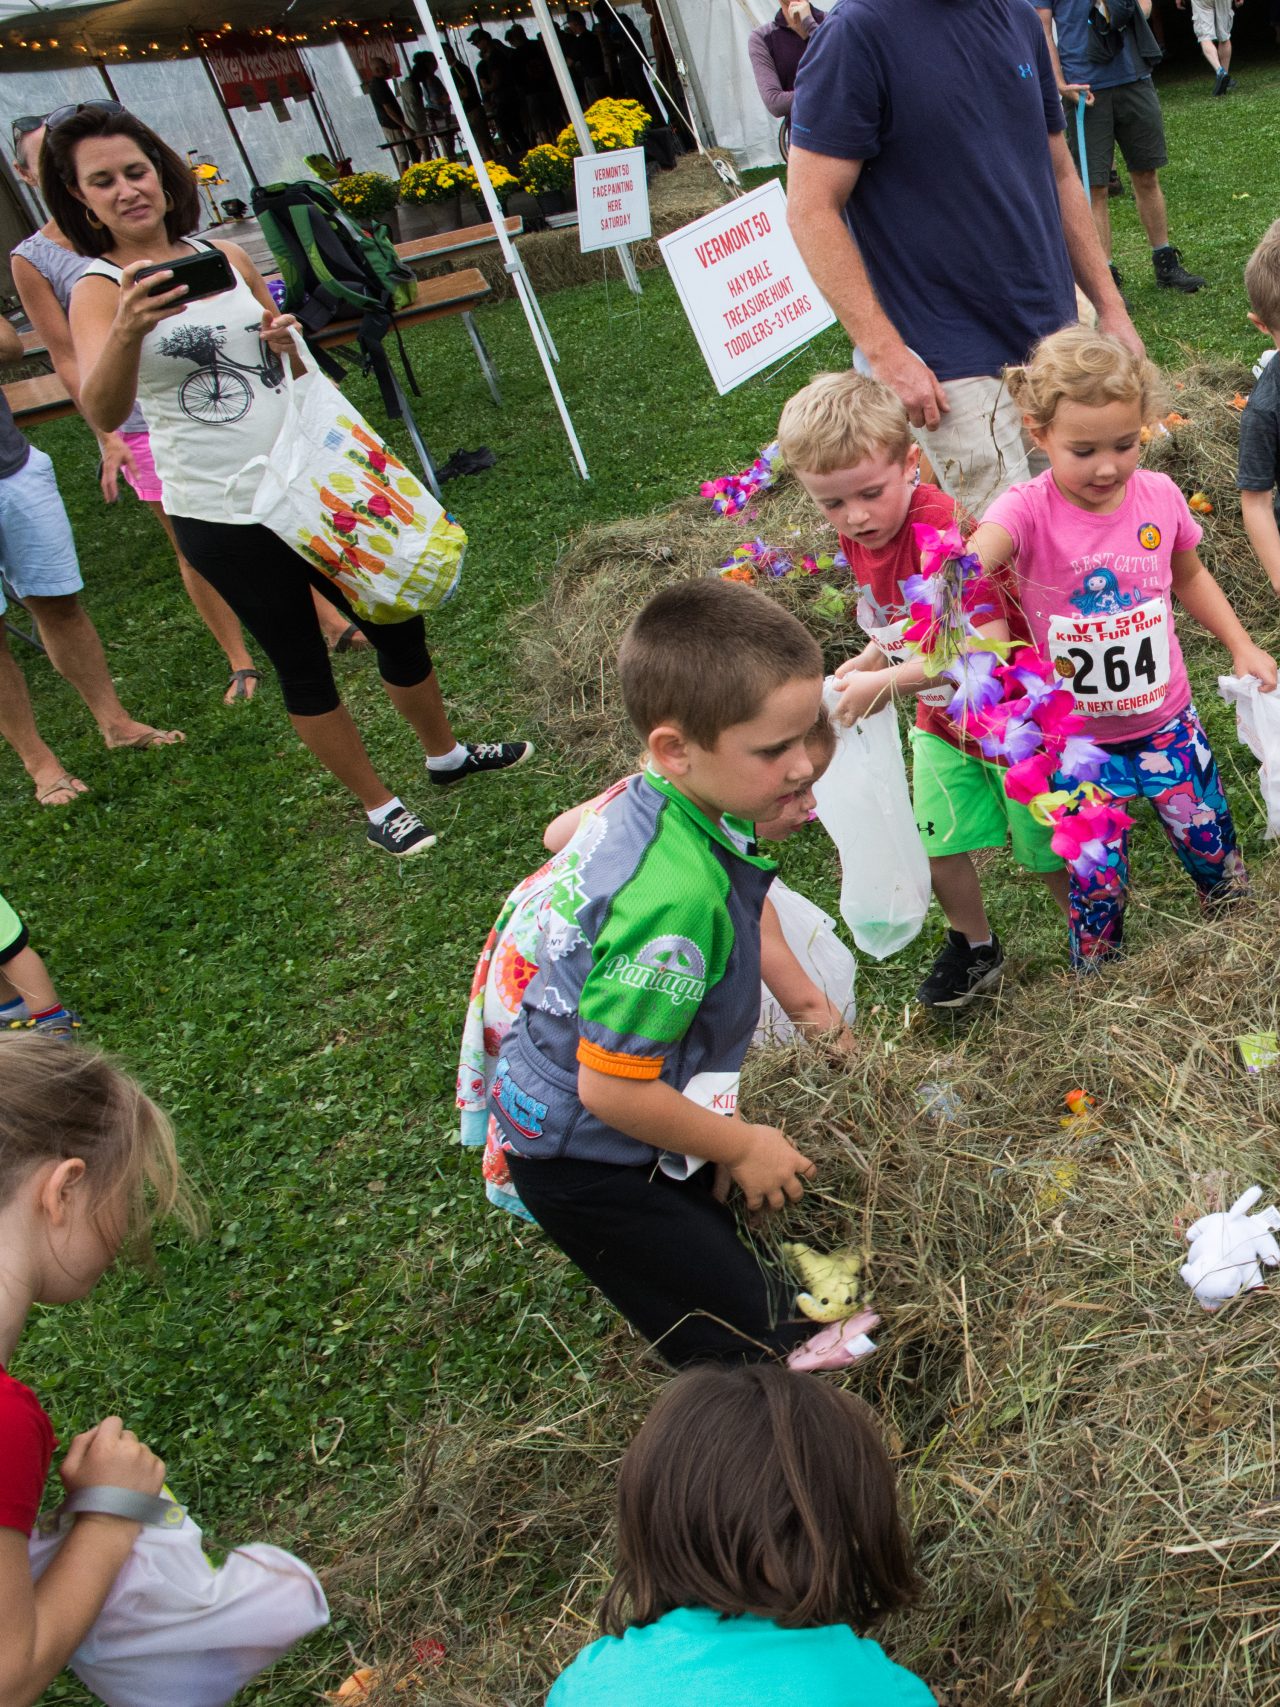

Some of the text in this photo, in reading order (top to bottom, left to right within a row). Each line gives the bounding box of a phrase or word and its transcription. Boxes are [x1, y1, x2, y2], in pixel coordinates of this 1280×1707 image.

[594, 164, 630, 181] VERMONT 50
[607, 199, 622, 212] HERE
[600, 213, 631, 230] SATURDAY
[694, 211, 772, 269] VERMONT 50
[722, 275, 795, 330] TREASURE HUNT
[782, 295, 813, 322] YEARS
[1070, 552, 1159, 575] BEST CATCH
[1056, 614, 1162, 643] KIDS FUN RUN
[1073, 621, 1106, 635] VT
[1115, 610, 1146, 629] 50
[1067, 636, 1157, 695] 264
[1087, 700, 1113, 712] NEXT
[1116, 683, 1168, 712] GENERATION
